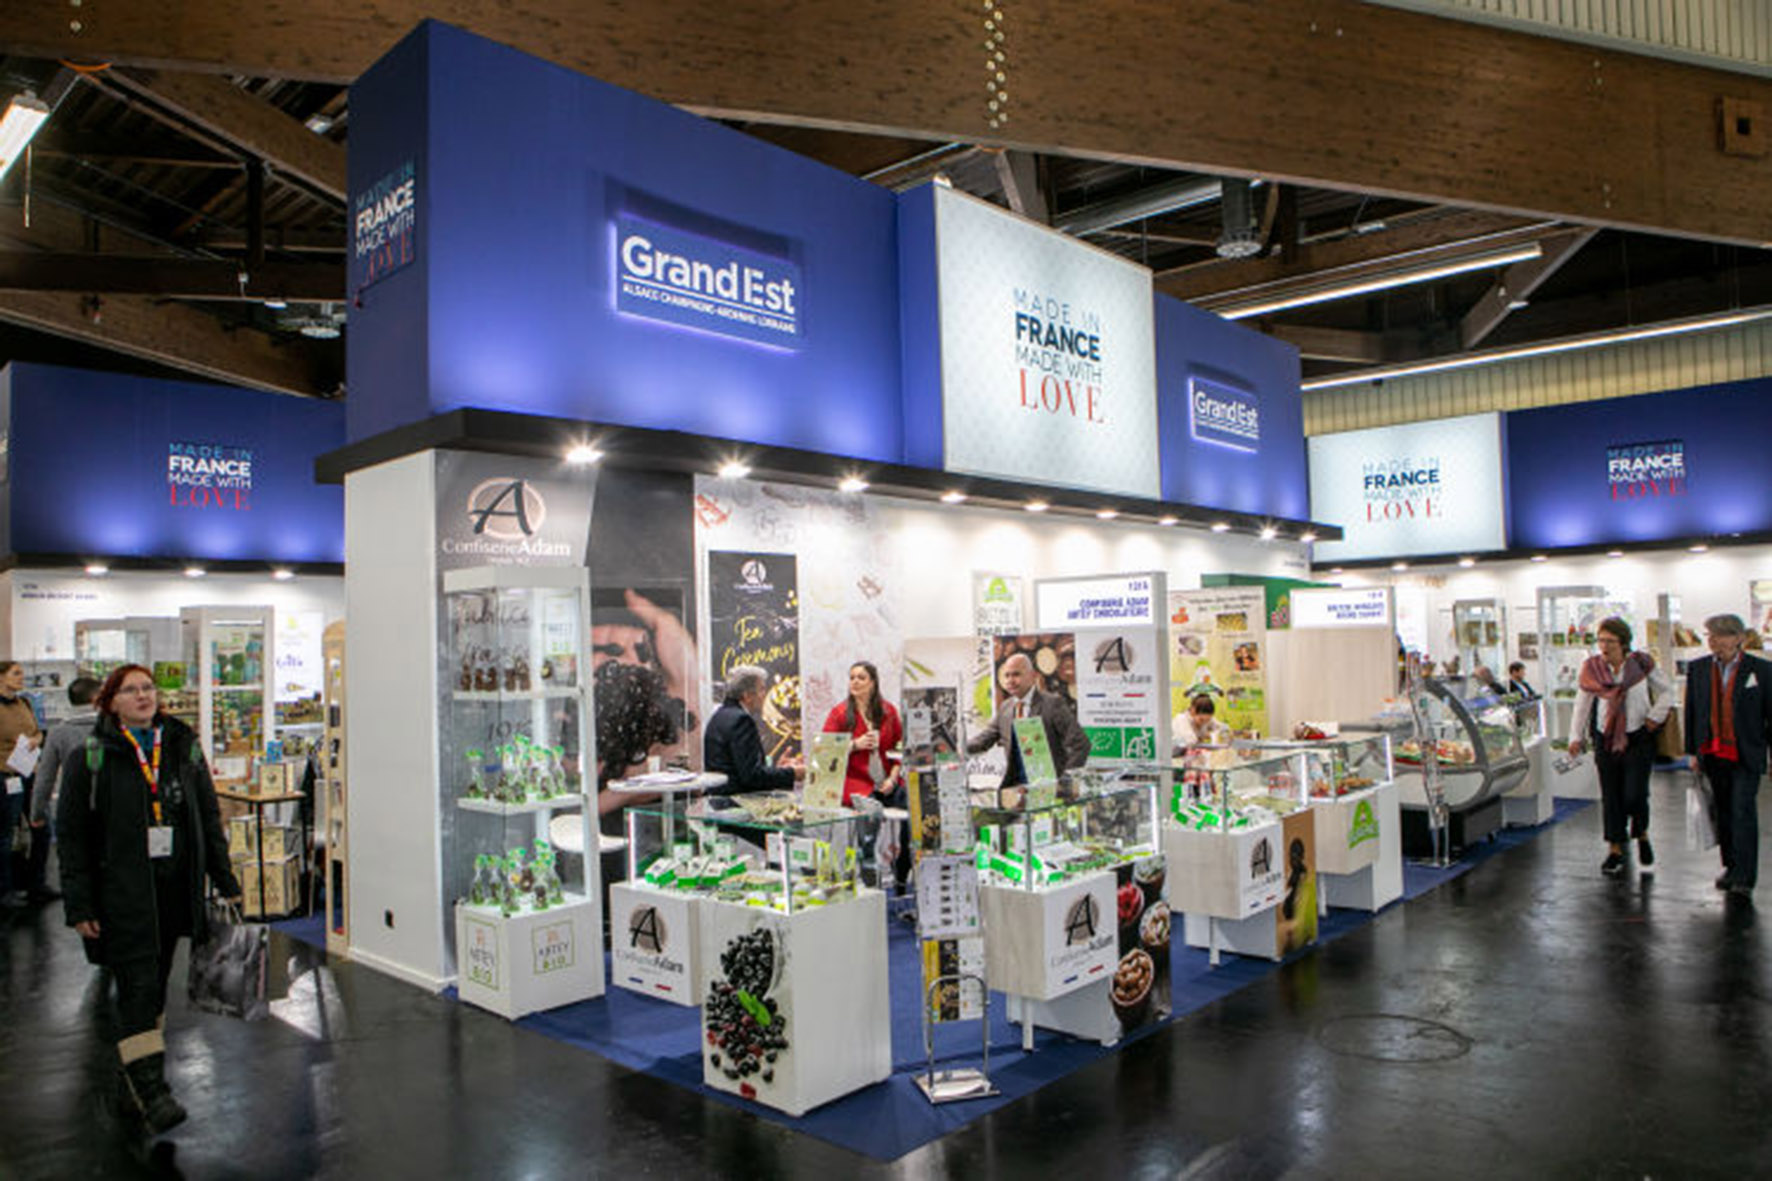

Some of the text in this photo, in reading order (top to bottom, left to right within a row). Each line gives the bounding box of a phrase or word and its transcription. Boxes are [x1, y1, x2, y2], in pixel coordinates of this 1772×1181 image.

[356, 178, 415, 241] FRANCE
[623, 235, 796, 314] Grand Est
[1013, 287, 1100, 333] MADE IN
[1015, 311, 1101, 362] FRANCE
[1014, 344, 1102, 384] MADE WITH
[1020, 367, 1105, 424] LOVE
[1195, 391, 1238, 422] Grand
[1237, 403, 1259, 430] Est
[169, 455, 252, 477] FRANCE
[169, 471, 252, 490] MADE WITH
[1364, 468, 1441, 490] FRANCE
[1608, 453, 1684, 474] FRANCE
[170, 484, 252, 511] LOVE
[1366, 498, 1443, 523] LOVE
[734, 614, 765, 648] Tea
